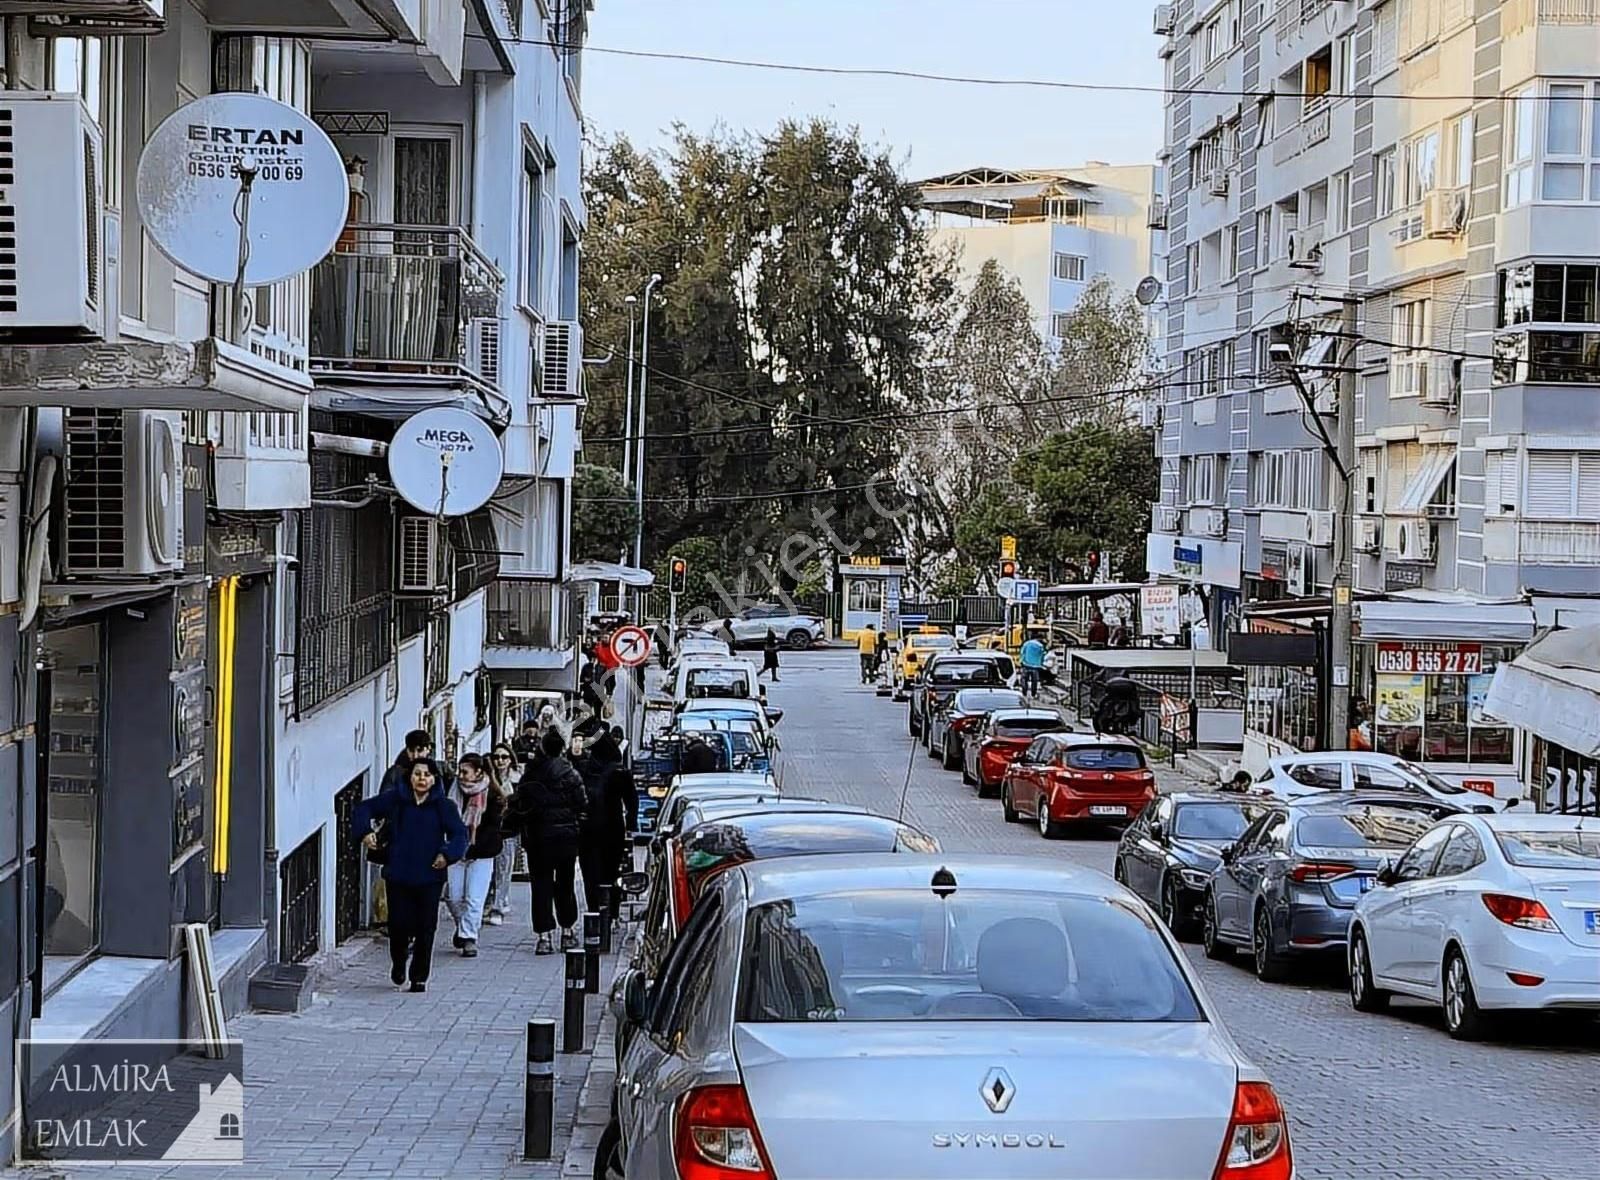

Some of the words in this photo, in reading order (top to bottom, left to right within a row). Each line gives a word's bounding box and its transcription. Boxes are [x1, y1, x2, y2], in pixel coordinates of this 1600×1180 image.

[187, 125, 304, 145] ERTAN
[188, 162, 225, 179] 0536
[261, 166, 280, 180] 00
[285, 166, 303, 180] 69
[424, 429, 471, 442] MEGA
[1380, 651, 1412, 671] 0538
[1417, 652, 1441, 671] 555
[1445, 653, 1460, 672] 27
[1463, 653, 1479, 672] 27
[932, 1133, 1065, 1148] SYMBOL
